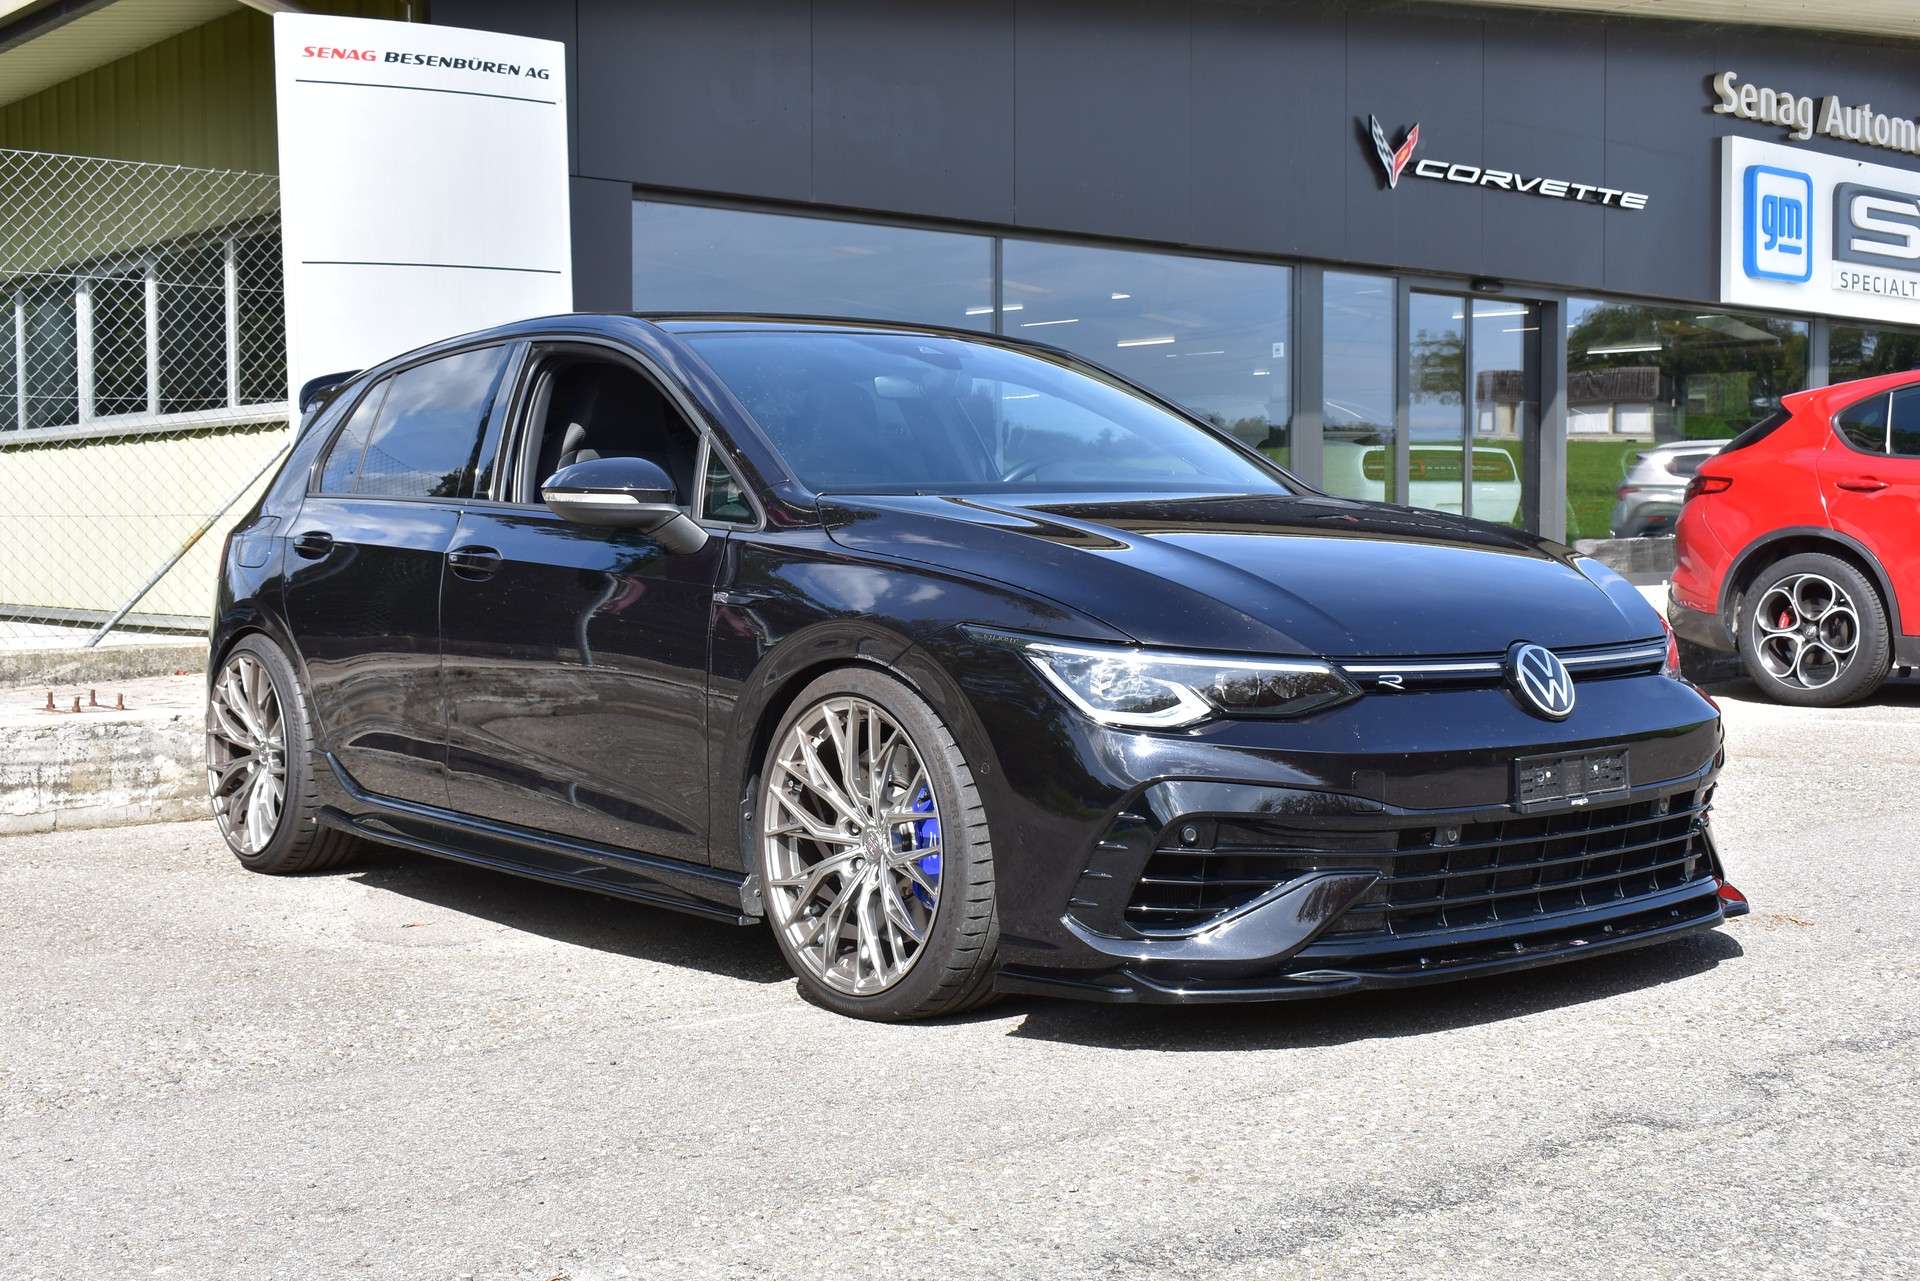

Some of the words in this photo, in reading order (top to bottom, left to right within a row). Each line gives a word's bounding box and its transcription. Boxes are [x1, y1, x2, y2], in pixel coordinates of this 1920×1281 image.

[302, 46, 377, 62] SENAG
[383, 50, 521, 76] BESENBÜREN
[524, 66, 550, 80] AG
[1713, 71, 1814, 141] Senag
[1818, 95, 1920, 155] Autom
[1415, 159, 1649, 210] CORVETTE
[1761, 194, 1803, 254] gm
[1850, 195, 1920, 259] S
[1840, 271, 1920, 297] SPECIALT
[1379, 674, 1405, 690] R
